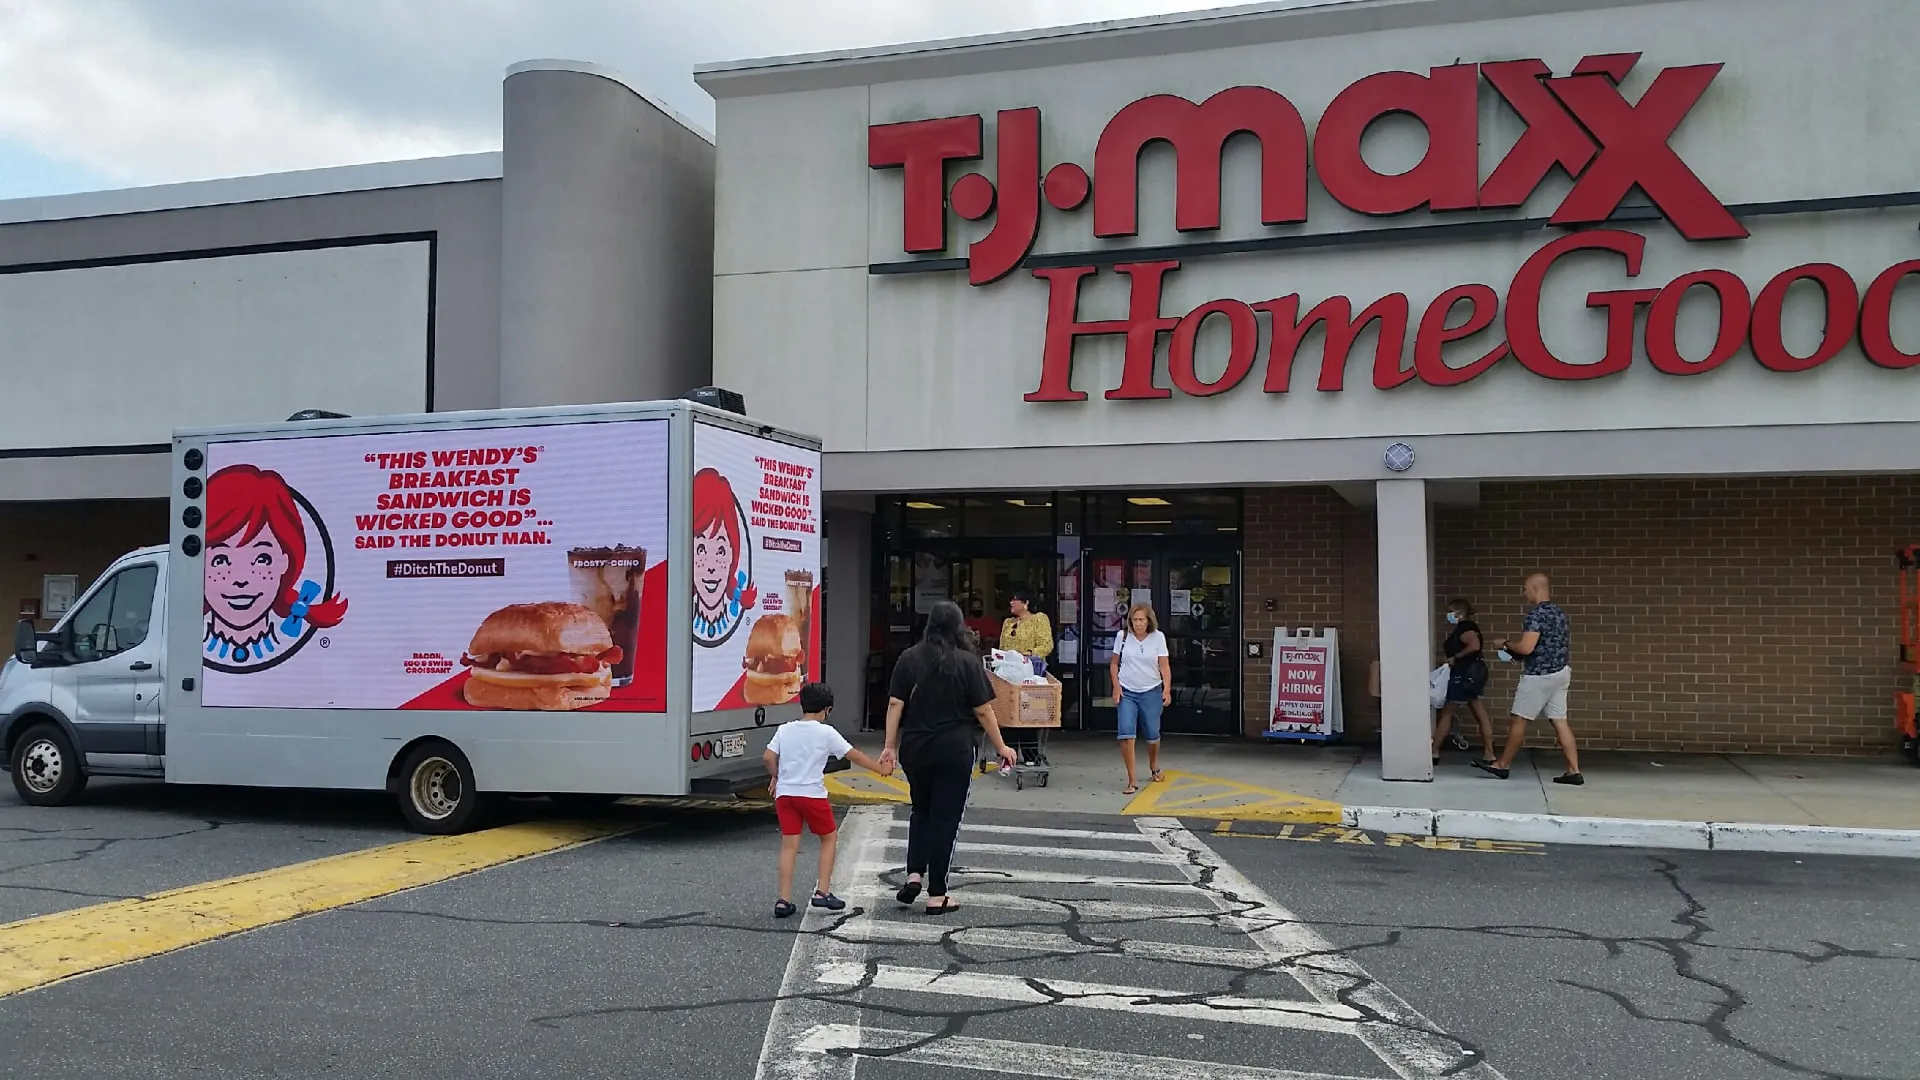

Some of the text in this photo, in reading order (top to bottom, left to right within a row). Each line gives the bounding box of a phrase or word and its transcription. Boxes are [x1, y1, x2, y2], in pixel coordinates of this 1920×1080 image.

[389, 468, 520, 489] BREAKFAST
[763, 473, 806, 491] BREAKFAST
[377, 488, 531, 510] SANDWICH IS
[759, 487, 809, 507] SANDWICH IS
[751, 500, 783, 517] WICKED
[355, 512, 447, 531] WICKED
[751, 516, 766, 527] SAID
[767, 519, 778, 528] THE
[780, 520, 799, 531] DONUT
[1066, 523, 1071, 534] 9
[355, 531, 552, 549] SAID THE DONUT MAN.
[393, 562, 498, 576] #DitchTheDonut
[1288, 670, 1317, 680] NOW
[1281, 683, 1322, 695] HIRING
